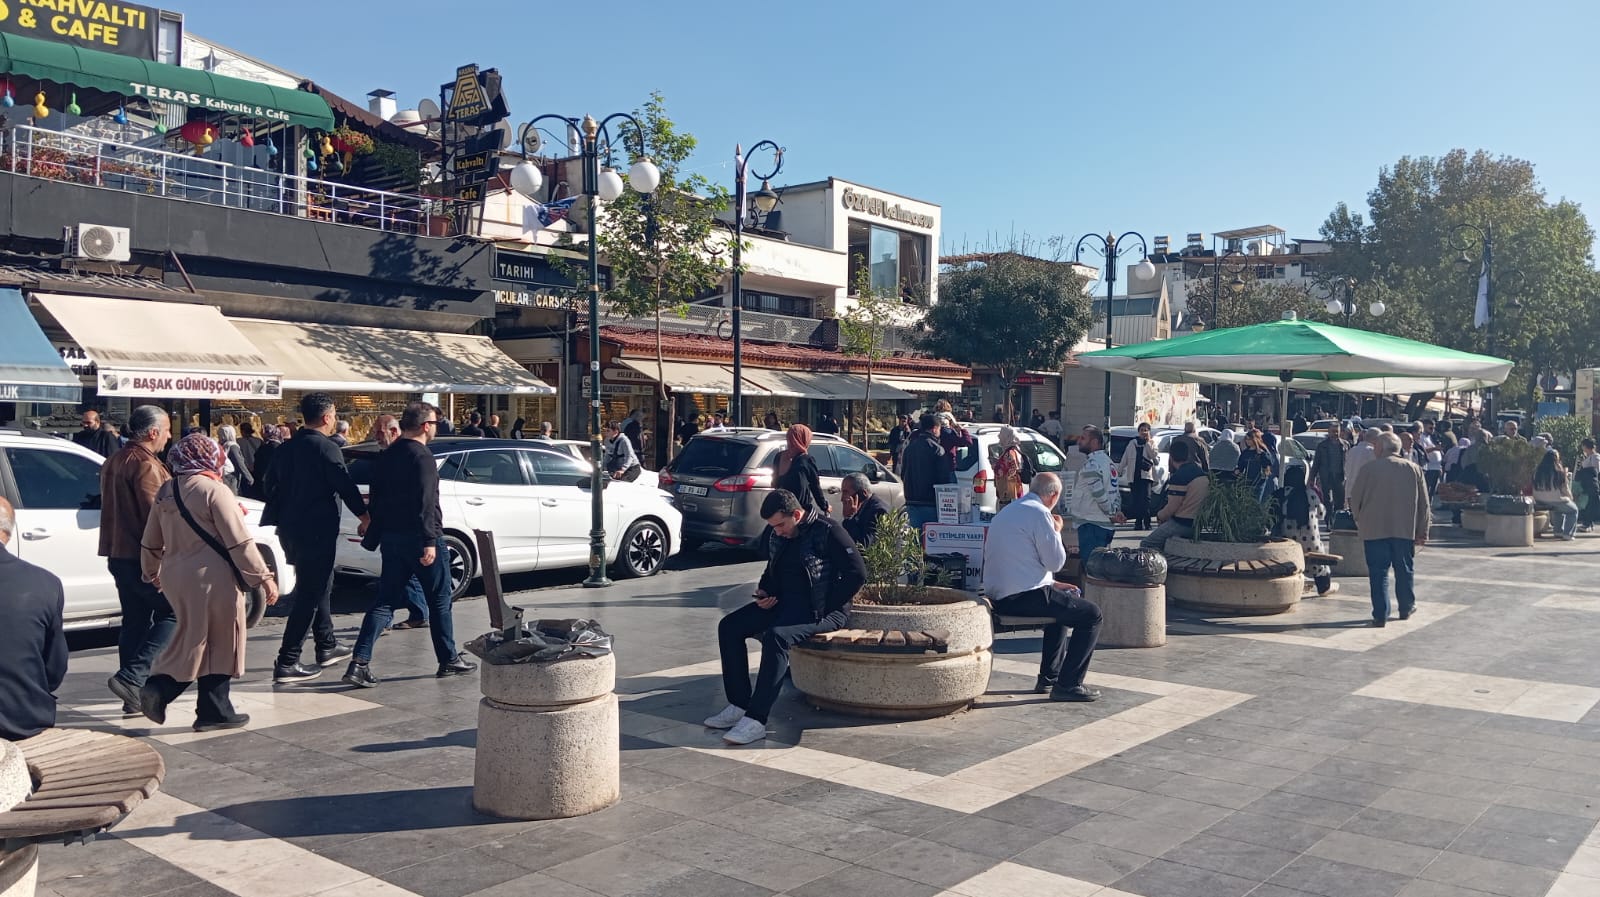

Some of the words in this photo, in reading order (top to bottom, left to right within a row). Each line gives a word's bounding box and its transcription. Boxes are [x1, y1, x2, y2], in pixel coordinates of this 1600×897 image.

[18, 8, 37, 28] &
[51, 15, 118, 46] CAFE
[130, 82, 201, 105] TERAS
[205, 97, 251, 115] Kahvaltı
[254, 106, 263, 116] &
[265, 109, 290, 121] Cafe
[455, 104, 480, 119] TERAS
[460, 187, 477, 200] Cafe
[133, 377, 173, 393] BAŞAK
[176, 377, 251, 393] GÜMÜŞÇÜLÜK
